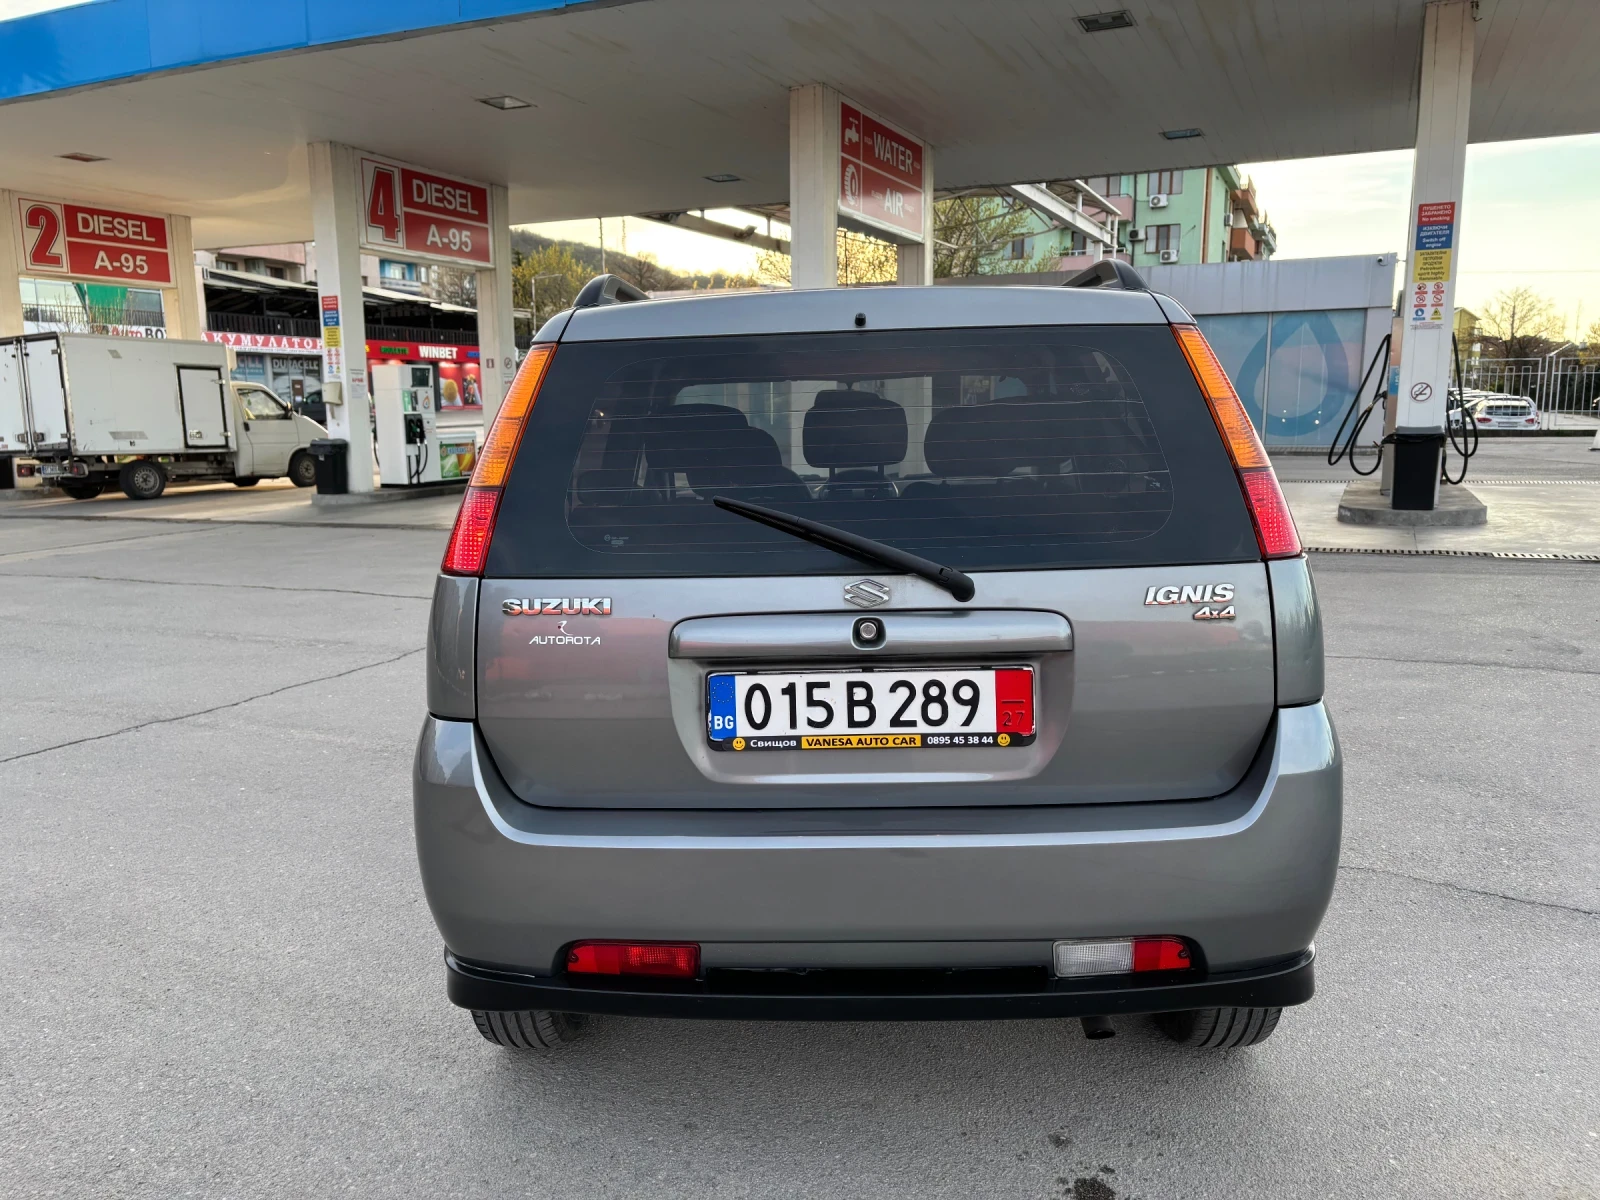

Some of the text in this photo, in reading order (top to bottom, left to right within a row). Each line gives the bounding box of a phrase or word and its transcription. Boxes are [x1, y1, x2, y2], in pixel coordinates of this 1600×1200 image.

[873, 131, 913, 175] WATER
[367, 166, 401, 243] 4
[412, 178, 479, 215] DIESEL
[884, 188, 904, 218] AIR
[26, 204, 63, 268] 2
[77, 212, 156, 242] DIESEL
[426, 224, 472, 252] A-95
[94, 251, 149, 275] A-95
[145, 328, 167, 339] BO
[418, 345, 458, 359] WINBET
[1144, 583, 1235, 605] IGNIS
[501, 597, 612, 616] SUZUKI
[529, 635, 601, 645] AUTOROTA
[744, 678, 981, 731] 015 B 289
[713, 715, 734, 730] BG
[1002, 710, 1026, 726] 27
[750, 739, 797, 748] Свищов
[806, 736, 917, 747] VANESA AUTO CAR
[927, 736, 994, 745] 0895 45 38 44
